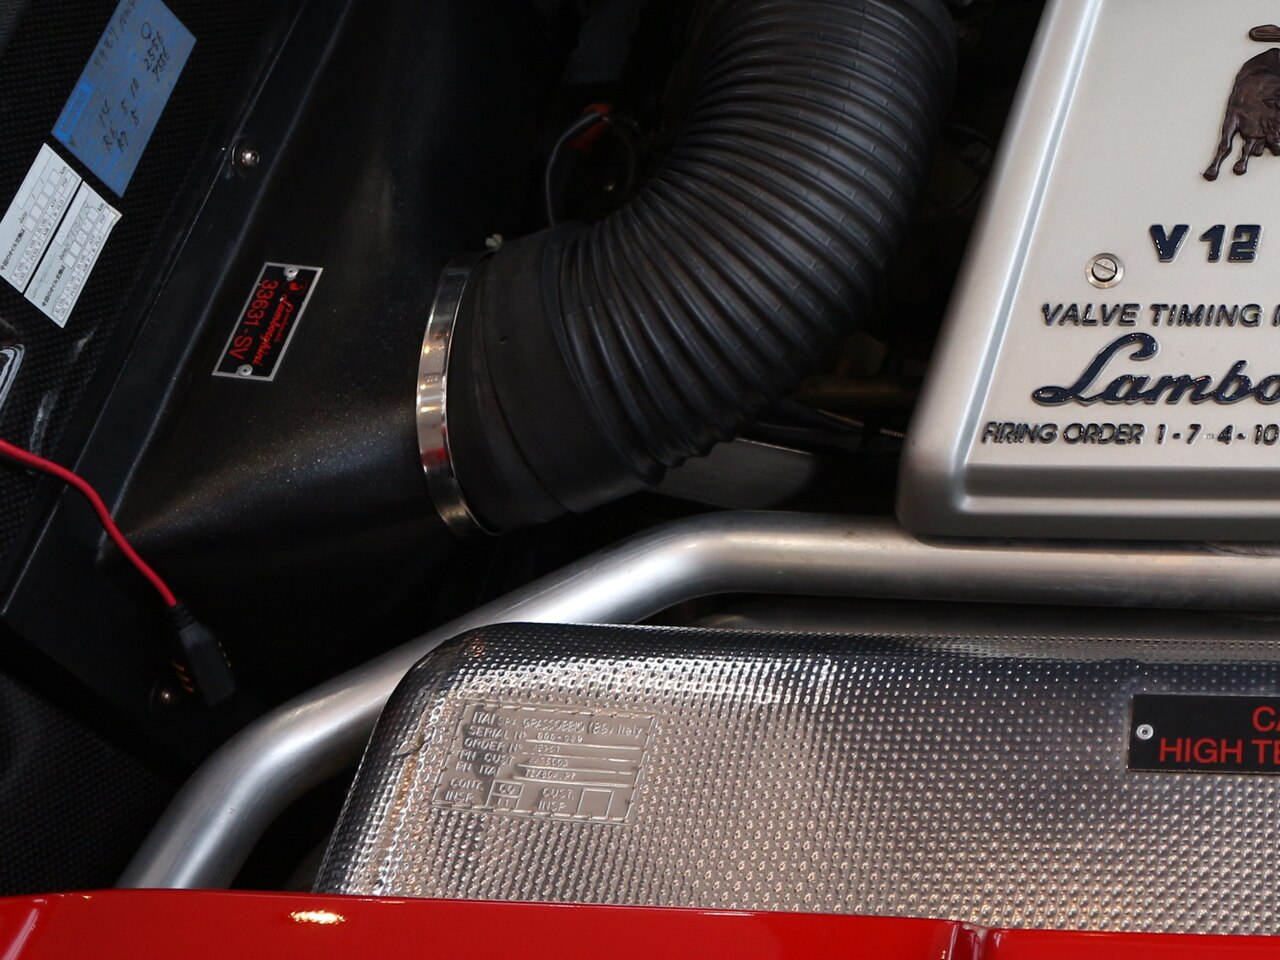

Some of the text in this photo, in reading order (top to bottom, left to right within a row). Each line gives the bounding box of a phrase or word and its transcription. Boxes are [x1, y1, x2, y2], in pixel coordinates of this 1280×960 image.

[1148, 223, 1262, 264] V12
[1040, 303, 1141, 328] VALVE
[1148, 303, 1264, 328] TIMING
[252, 294, 293, 366] Lamborghini
[981, 421, 1058, 444] FIRING
[1063, 422, 1145, 444] ORDER
[462, 739, 506, 751] ORDER
[466, 726, 511, 739] SERIAL
[1158, 737, 1243, 764] HIGH
